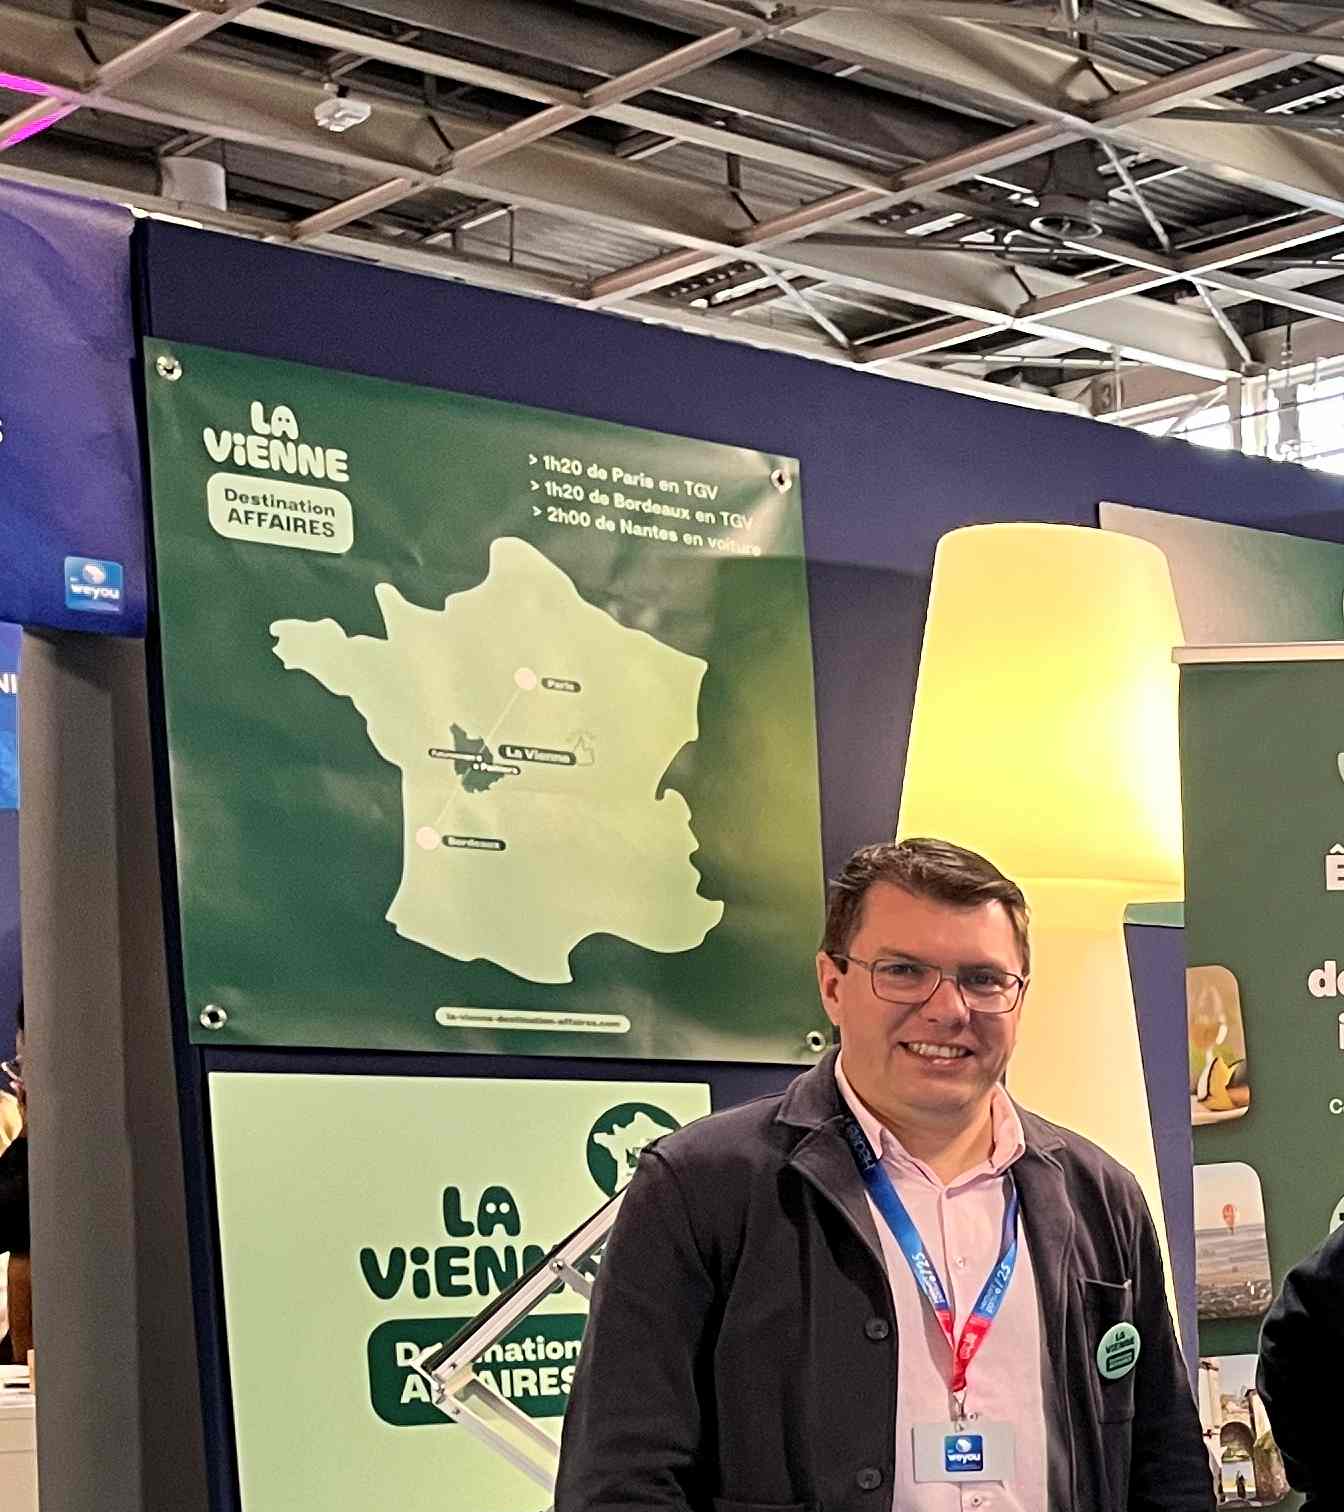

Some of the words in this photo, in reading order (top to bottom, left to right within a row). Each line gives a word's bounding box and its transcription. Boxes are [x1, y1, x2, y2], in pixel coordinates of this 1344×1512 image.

[251, 401, 299, 439] LA
[543, 455, 582, 475] 1h20
[587, 463, 607, 480] de
[612, 467, 654, 489] Paris
[659, 479, 679, 494] en
[684, 480, 718, 501] TGV
[224, 488, 336, 518] Destination
[544, 481, 584, 501] 1h20
[589, 489, 609, 506] de
[614, 492, 690, 521] Bordeaux
[695, 511, 716, 526] en
[720, 510, 754, 531] TGV
[228, 508, 336, 538] AFFAIRES
[547, 506, 590, 528] 2h00
[595, 514, 616, 532] de
[620, 518, 678, 543] Nantes
[683, 531, 704, 547] en
[707, 535, 762, 558] voiture
[443, 1186, 521, 1237] LA
[395, 1335, 582, 1367] Dnation
[400, 1365, 577, 1404] AAIRES
